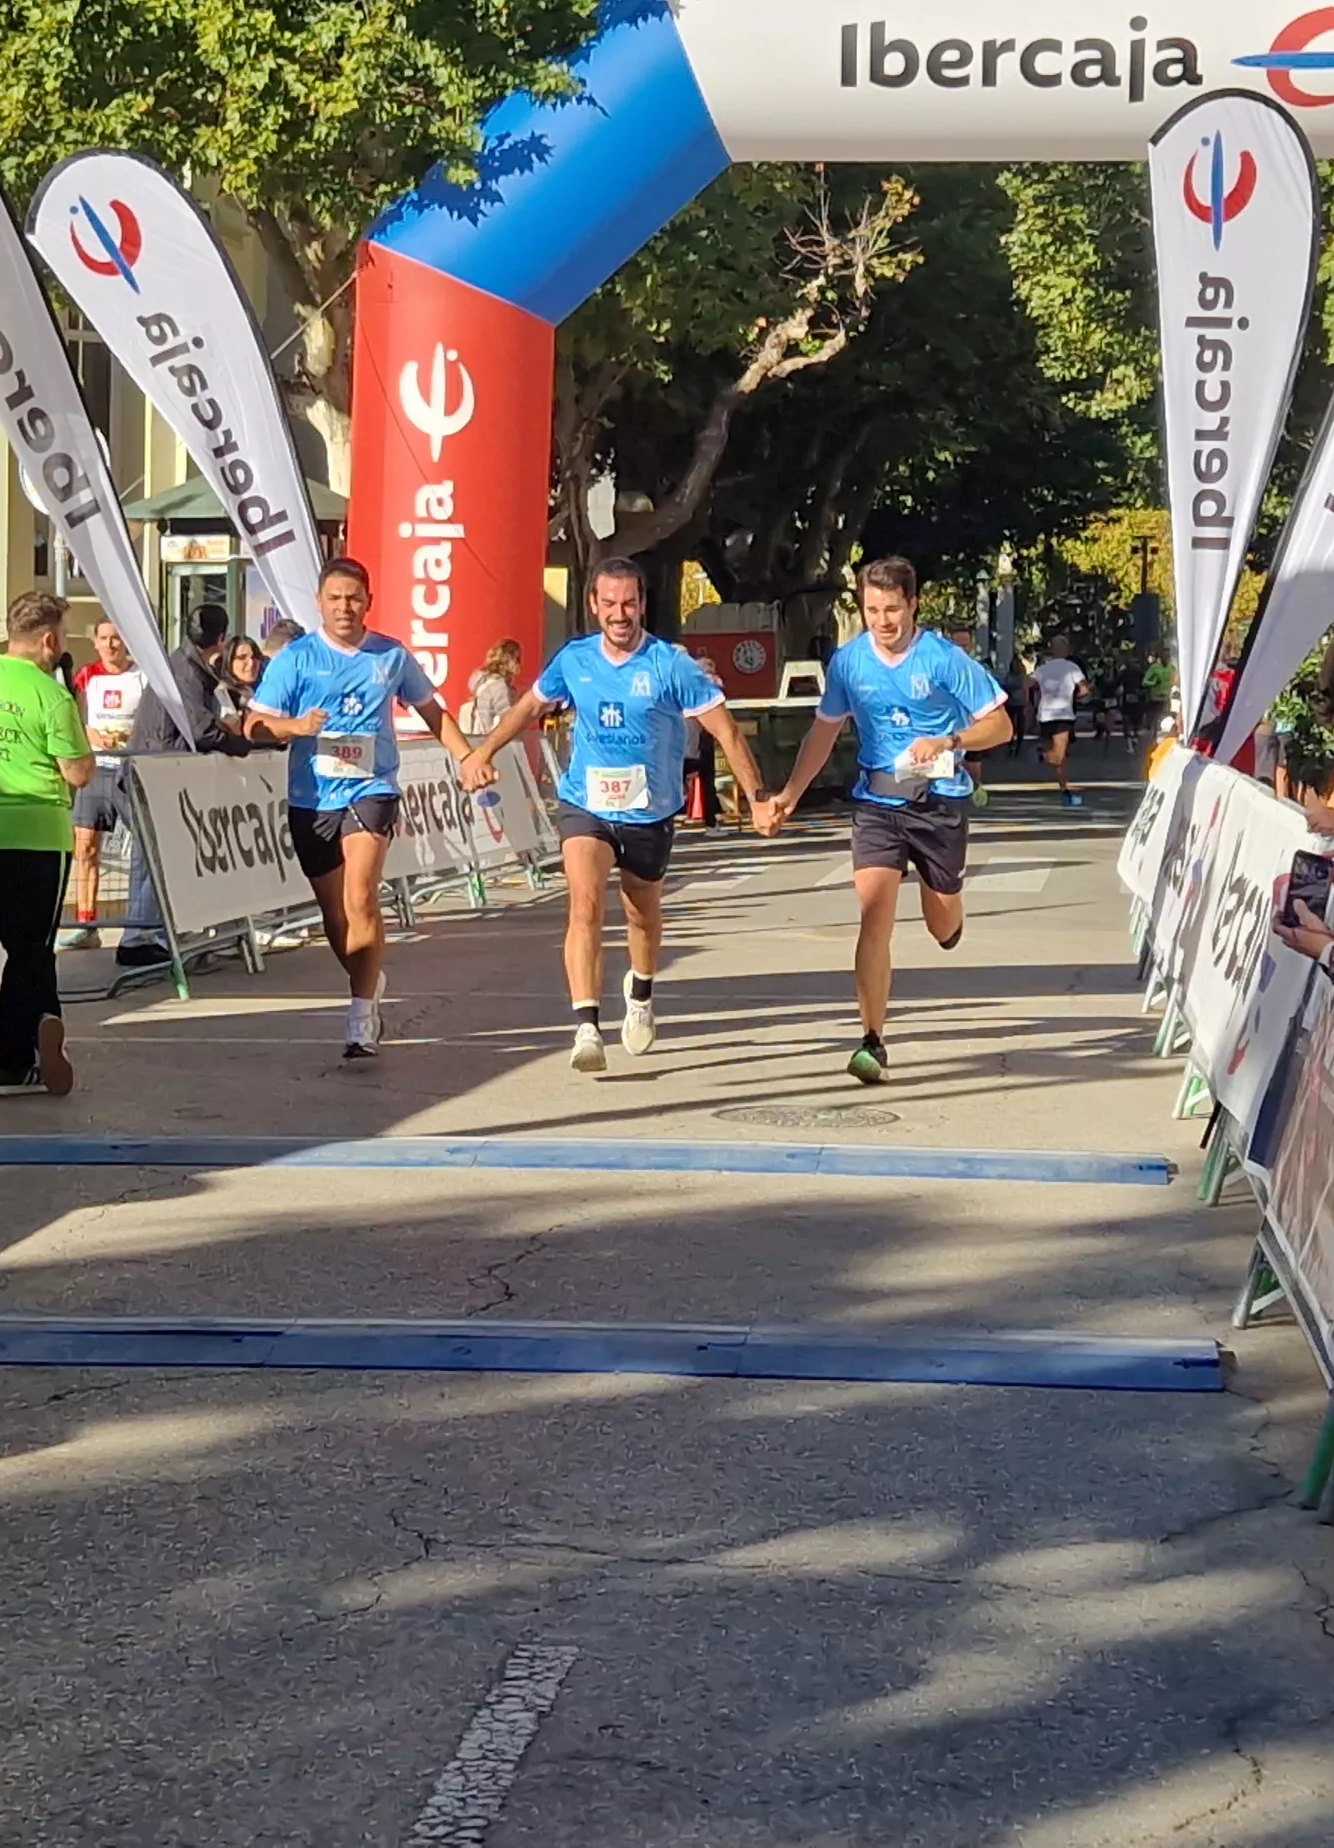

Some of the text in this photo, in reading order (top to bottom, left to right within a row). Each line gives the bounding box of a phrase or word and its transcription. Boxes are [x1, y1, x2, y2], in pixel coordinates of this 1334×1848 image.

[840, 16, 1204, 102] Ibercaja
[331, 744, 364, 760] 389
[598, 779, 633, 794] 387
